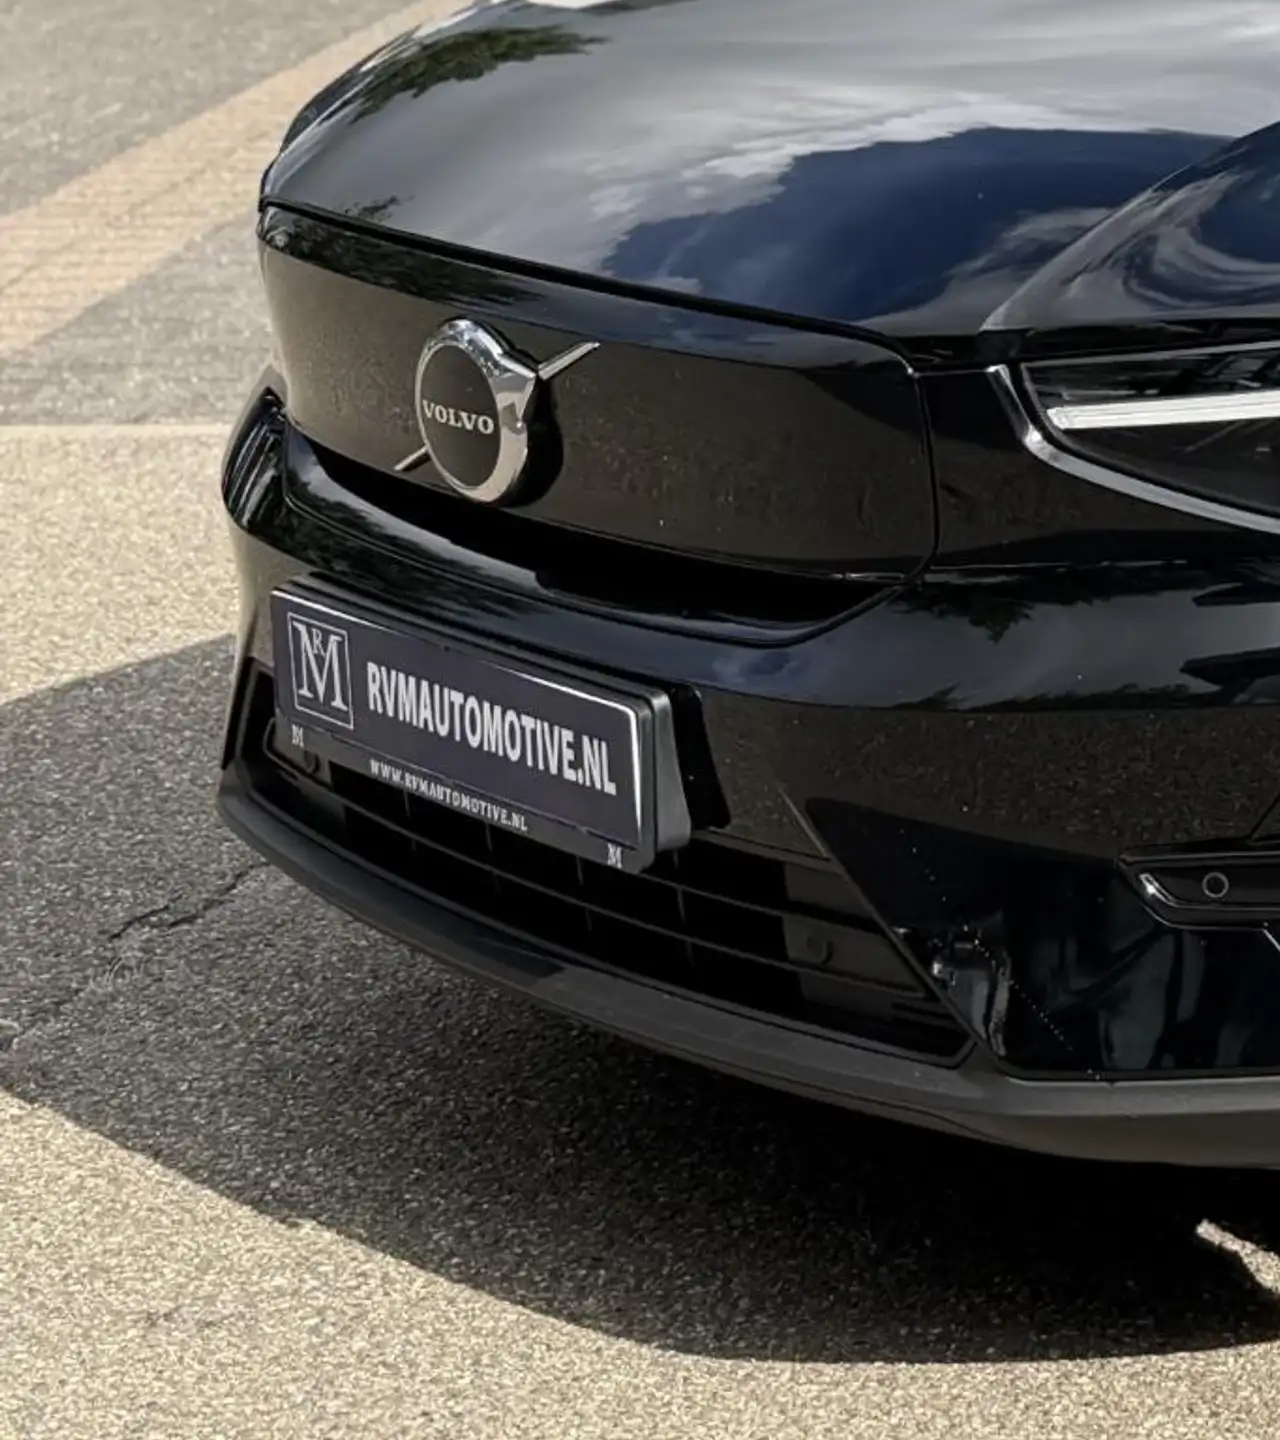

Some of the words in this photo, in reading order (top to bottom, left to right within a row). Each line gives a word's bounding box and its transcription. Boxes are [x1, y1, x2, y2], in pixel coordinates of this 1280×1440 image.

[422, 399, 495, 435] VOLVO
[366, 661, 618, 797] RVMAUTOMOTIVE.NL
[369, 758, 529, 832] WWW.RVMAUTOMOTIVE.NL
